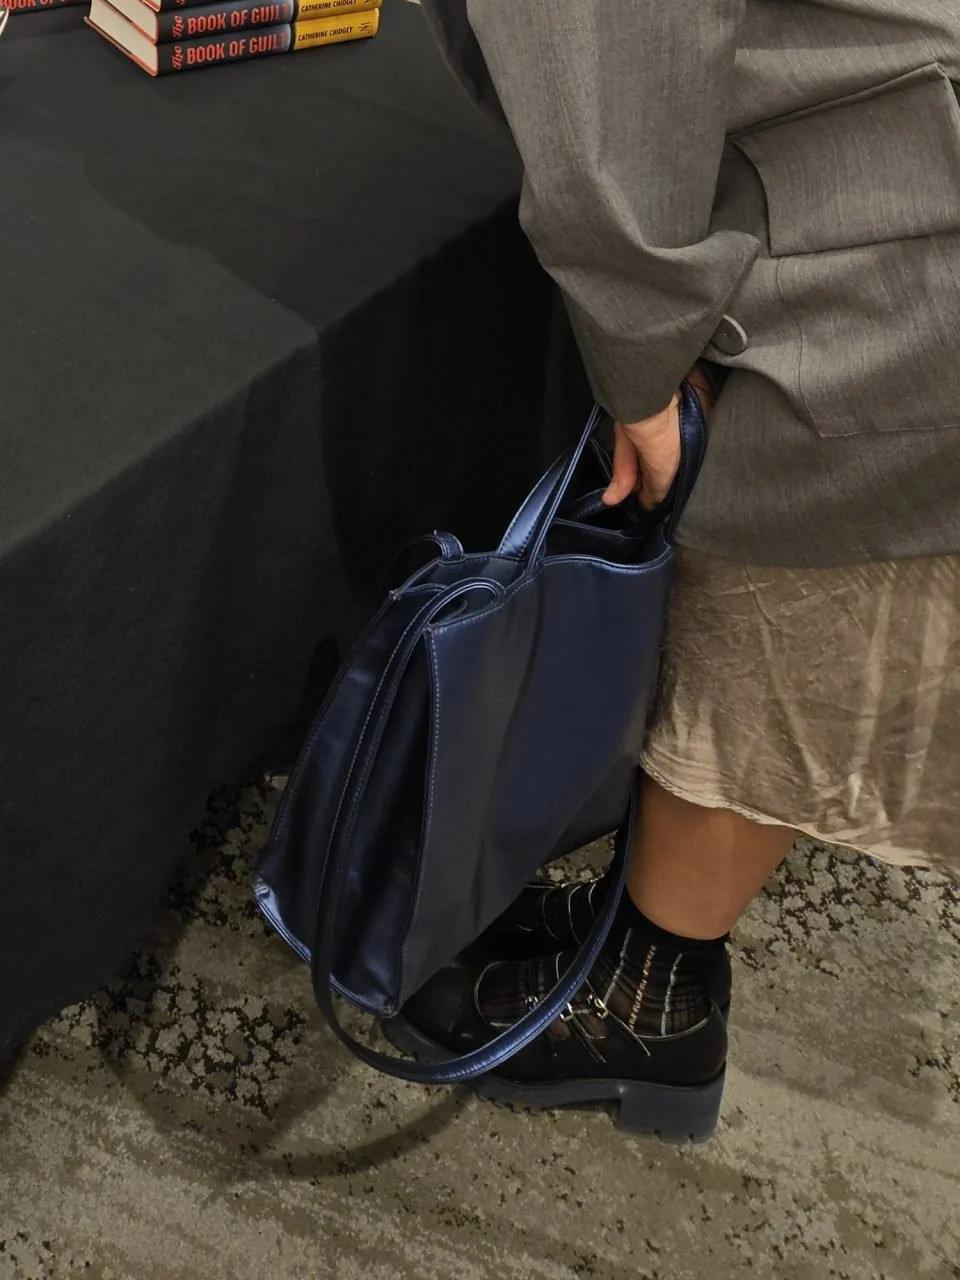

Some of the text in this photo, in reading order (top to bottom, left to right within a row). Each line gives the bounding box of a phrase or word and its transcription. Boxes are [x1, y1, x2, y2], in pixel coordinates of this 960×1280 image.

[301, 1, 331, 12] CATHERINE
[172, 3, 289, 39] The BOOK OF GUILT
[298, 26, 354, 42] CATHERINE CHIDGEY
[172, 31, 287, 70] The BOOK OF GUILT
